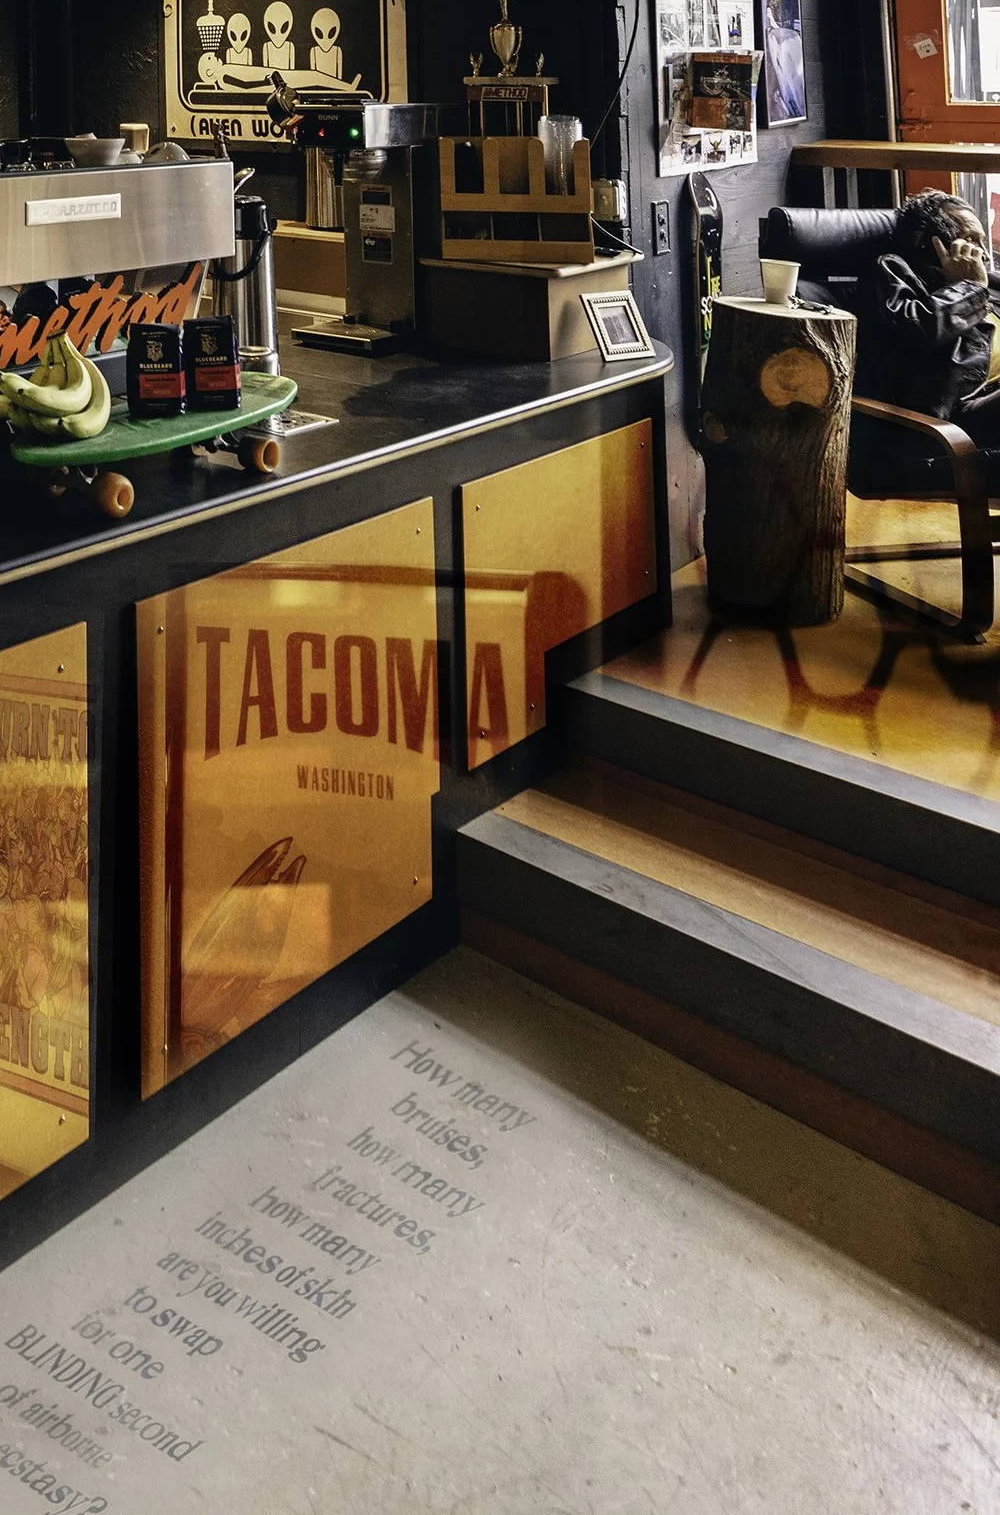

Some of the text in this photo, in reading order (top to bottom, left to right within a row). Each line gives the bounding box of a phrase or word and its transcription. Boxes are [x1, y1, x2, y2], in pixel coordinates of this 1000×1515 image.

[195, 355, 227, 363] BLUEBEARD
[196, 625, 512, 772] TACOMA
[296, 764, 395, 801] WASHINGTON
[390, 1040, 538, 1132] How many
[390, 1091, 488, 1170] bruises,
[310, 1164, 437, 1256] fractures,
[346, 1126, 486, 1218] how many
[195, 1212, 359, 1321] inches of skin
[249, 1186, 383, 1275] how many
[70, 1310, 167, 1381] for one
[123, 1285, 225, 1359] to swap
[156, 1250, 328, 1364] are you willing
[3, 1324, 204, 1463] BLINDING second
[18, 1402, 115, 1470] airborne
